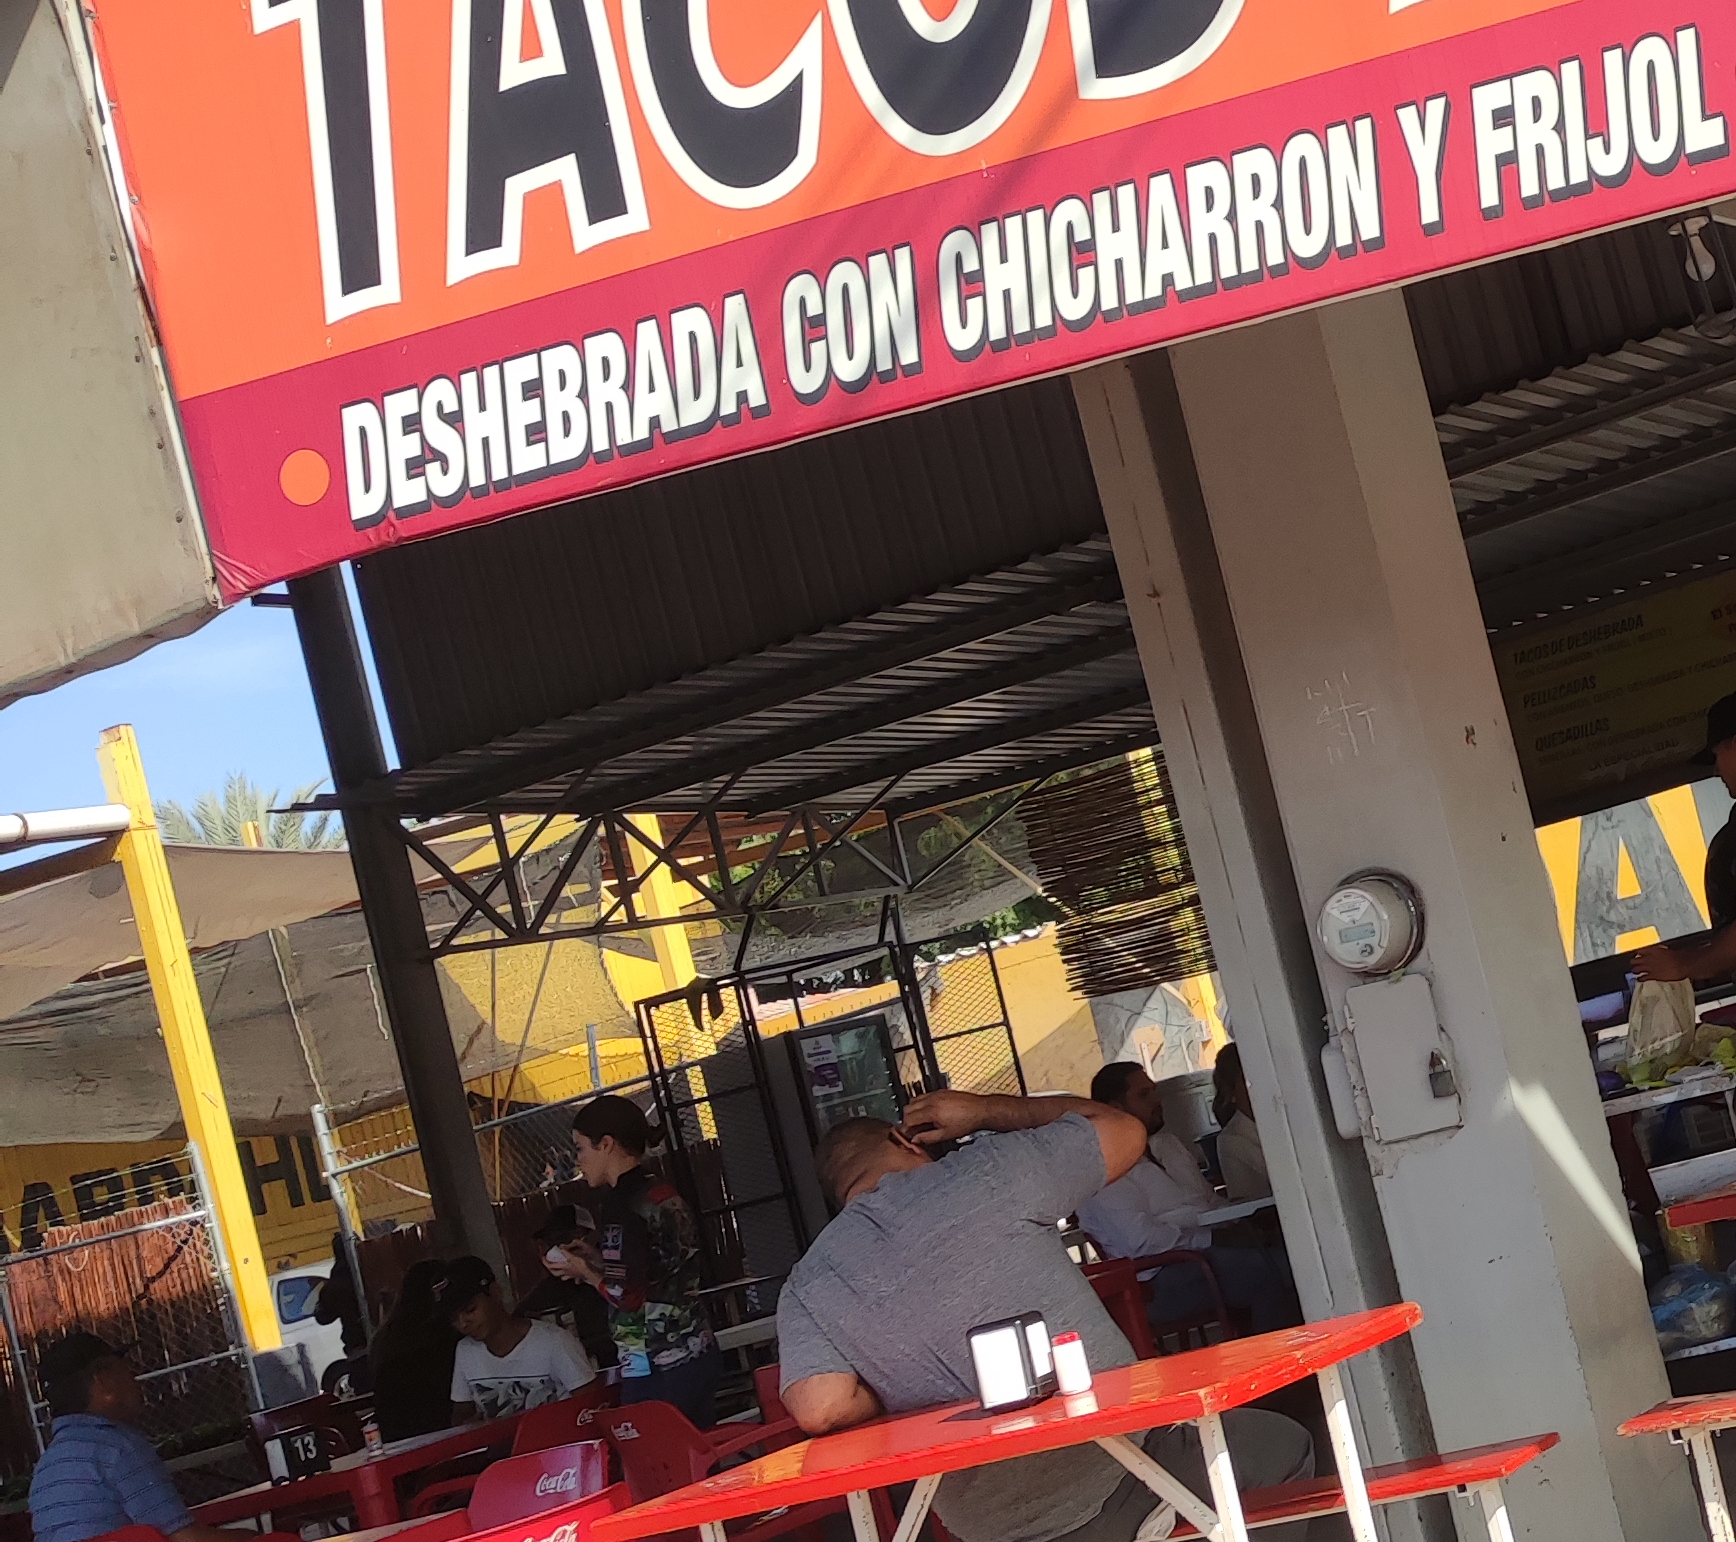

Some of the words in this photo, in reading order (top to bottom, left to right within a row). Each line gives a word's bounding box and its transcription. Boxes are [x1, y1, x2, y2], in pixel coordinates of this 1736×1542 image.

[340, 289, 767, 529] DESHEBRADA
[780, 244, 921, 398] CON
[939, 114, 1387, 356] CHICHARRON
[1396, 96, 1451, 234] Y
[1470, 26, 1729, 222] FRIJOL
[1513, 643, 1549, 665] TACOS
[1551, 638, 1565, 656] DE
[1567, 614, 1643, 651] DESHEBRADA
[1523, 675, 1597, 709] PELLIZCADAS
[1535, 717, 1609, 751] QUESADILLAS
[294, 1435, 317, 1462] 13
